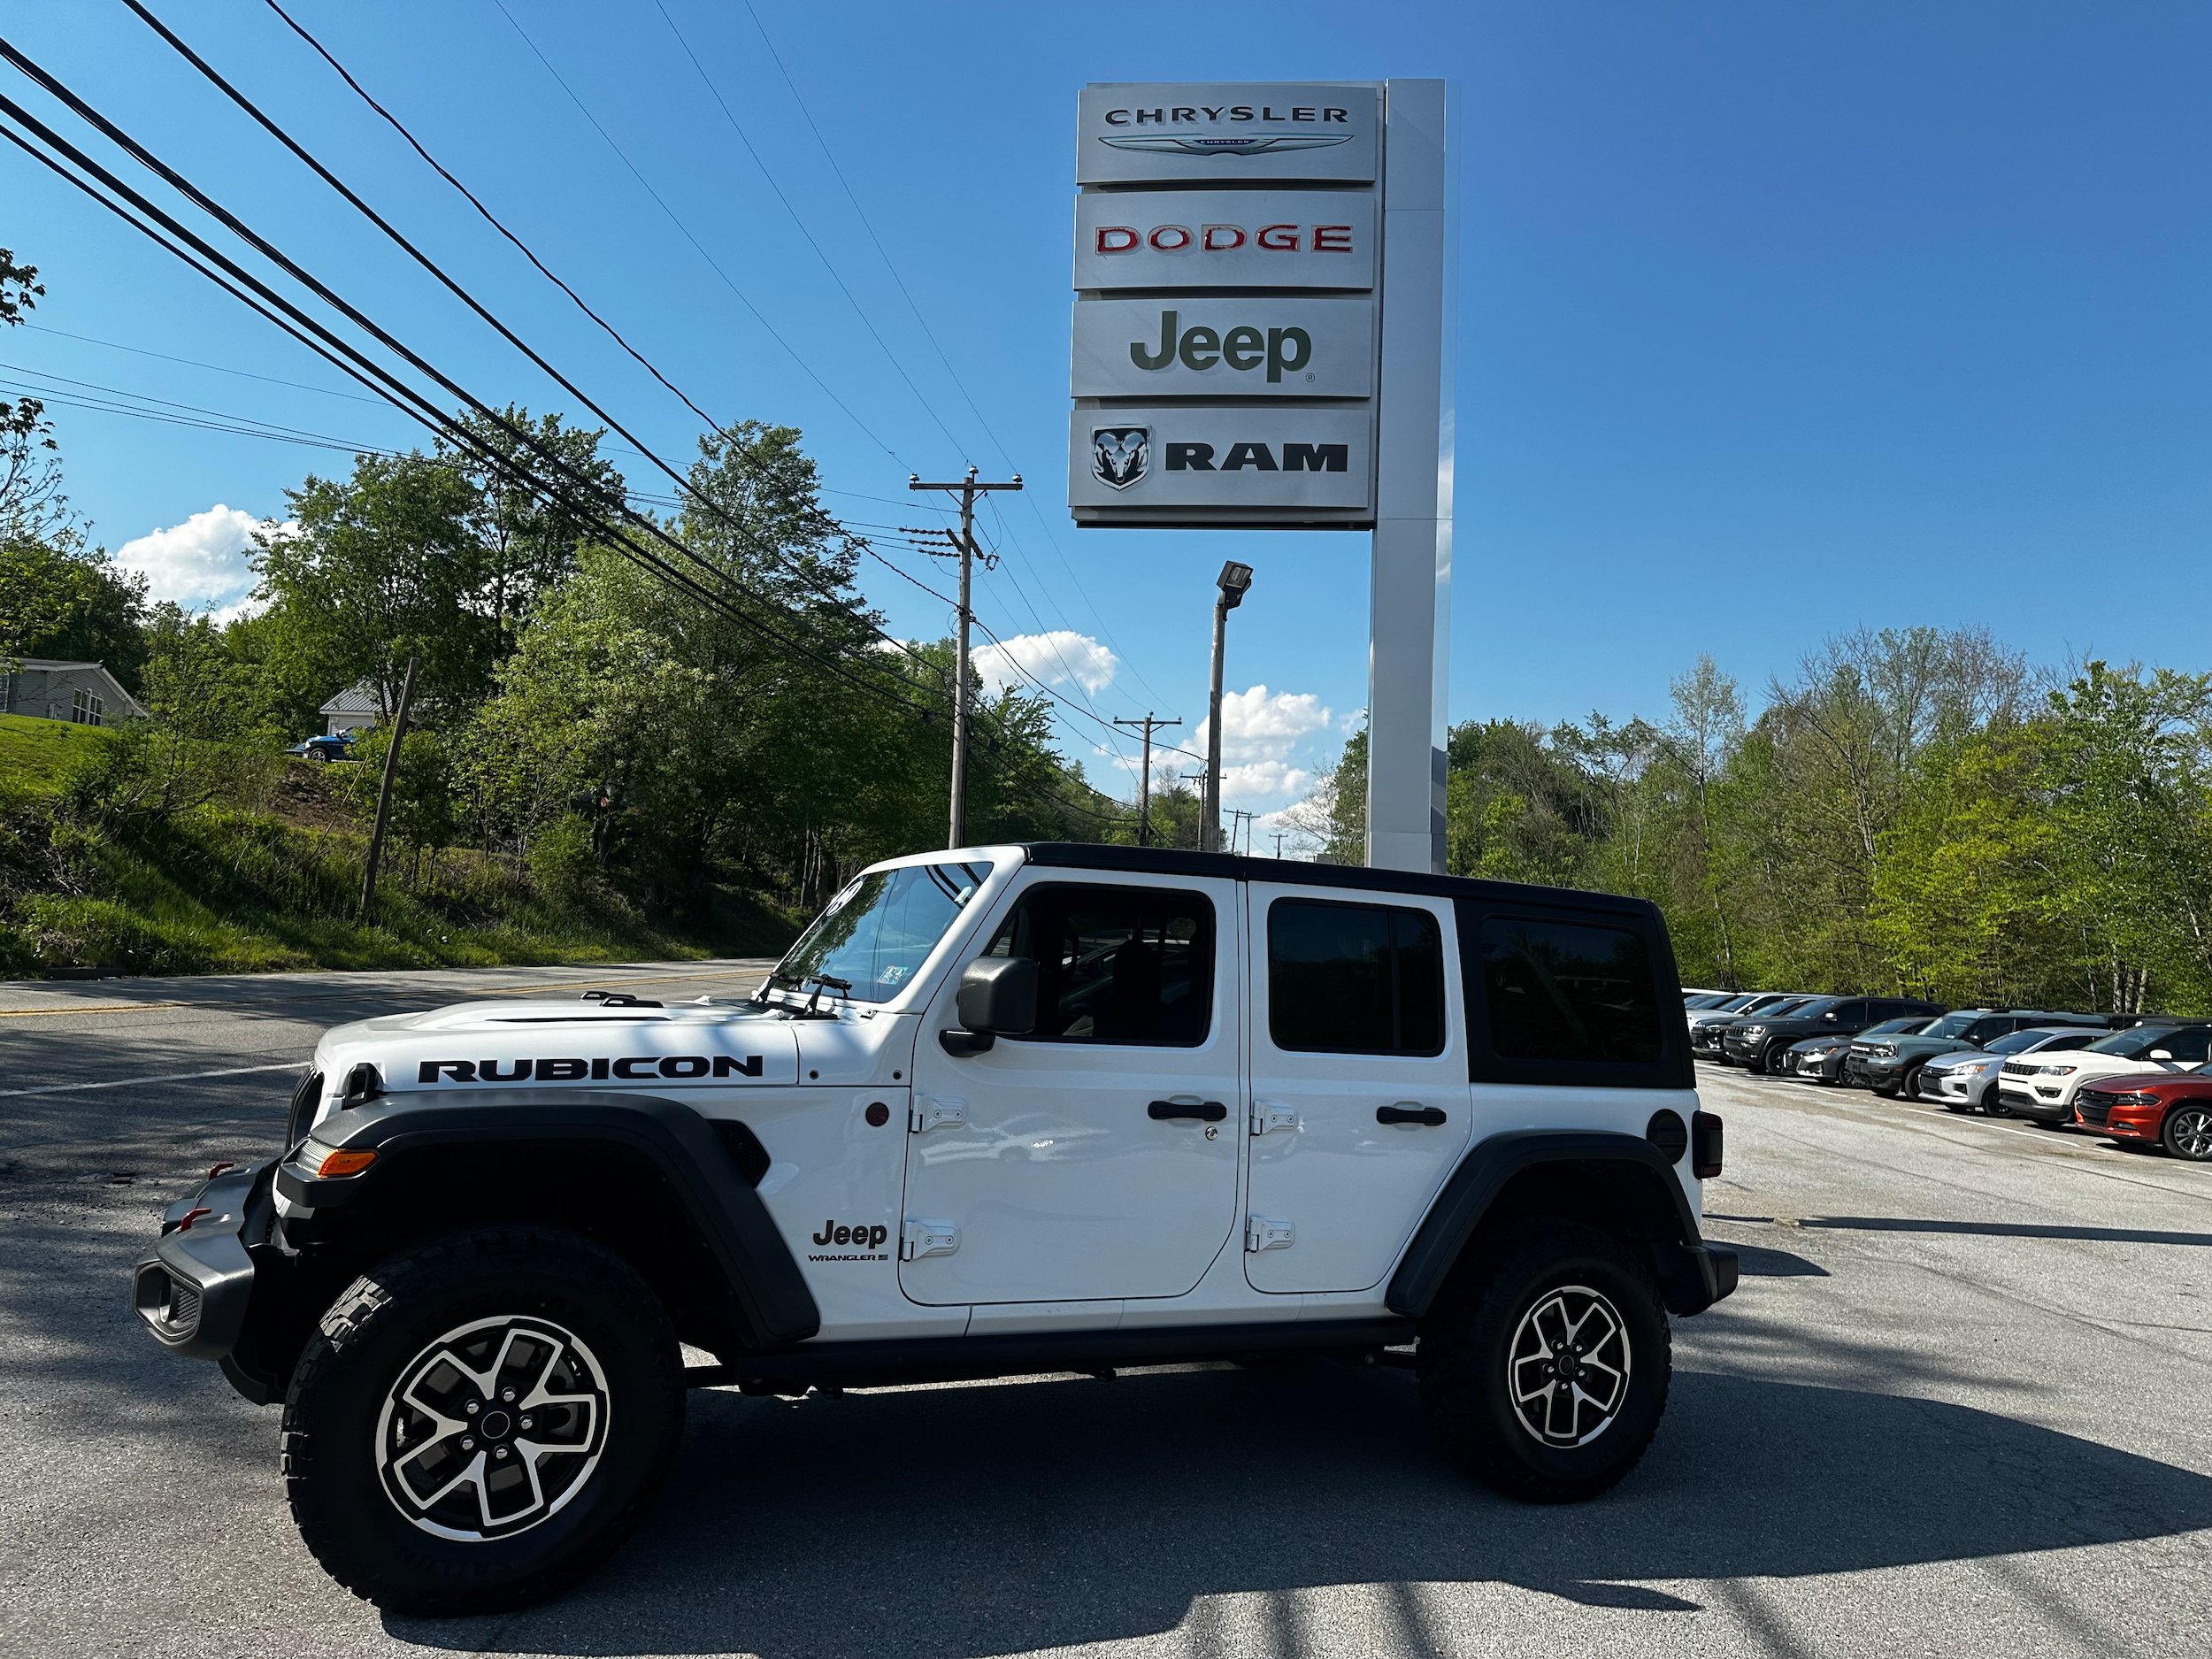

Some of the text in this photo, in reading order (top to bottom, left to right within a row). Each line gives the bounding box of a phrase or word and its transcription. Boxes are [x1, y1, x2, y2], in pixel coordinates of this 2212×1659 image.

[1105, 106, 1348, 125] CHRYSLER
[1095, 224, 1353, 254] DODGE
[1130, 311, 1311, 383] Jeep
[1165, 442, 1348, 472] RAM
[419, 1056, 763, 1083] RUBICON
[812, 1219, 887, 1249] Jeep
